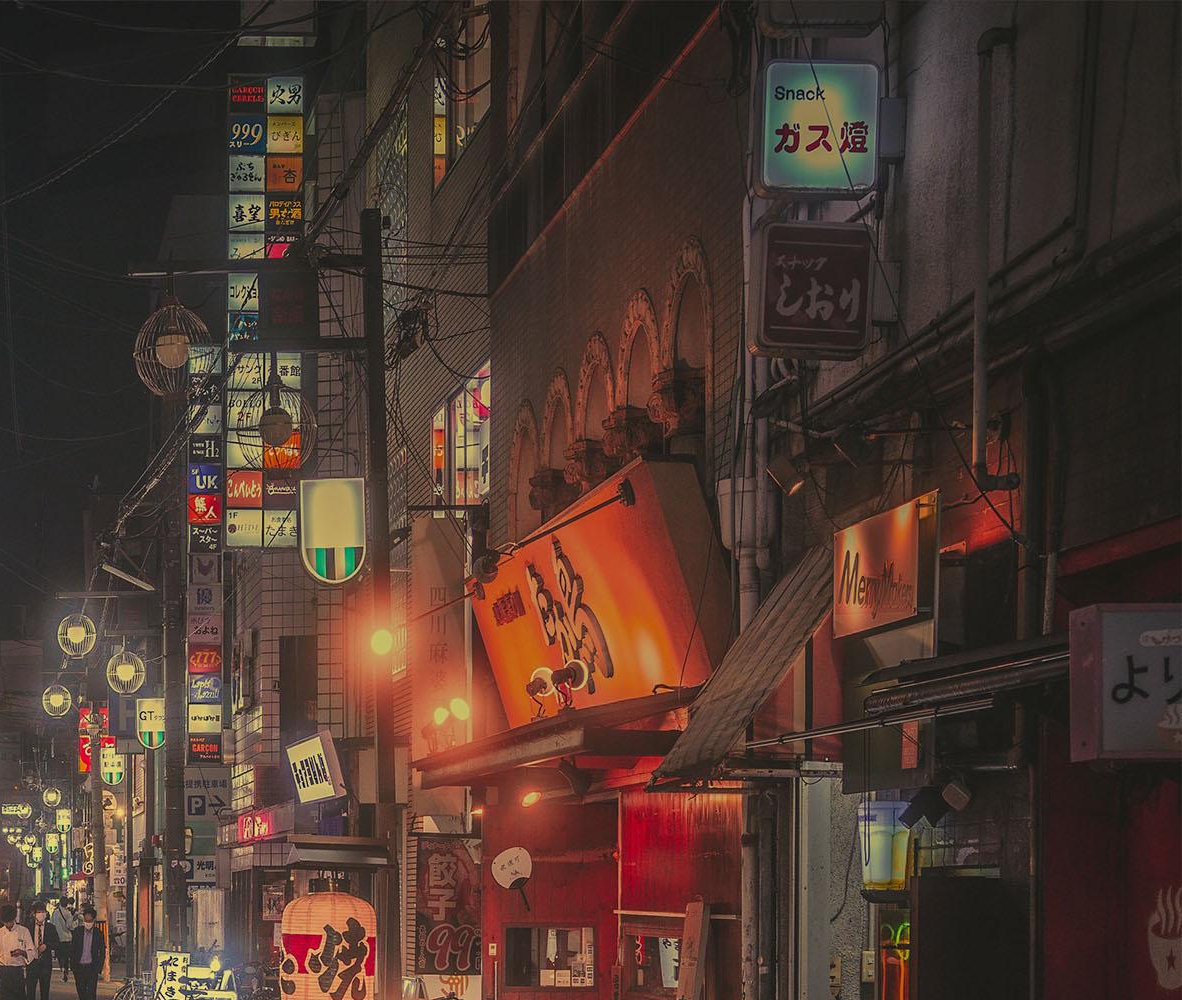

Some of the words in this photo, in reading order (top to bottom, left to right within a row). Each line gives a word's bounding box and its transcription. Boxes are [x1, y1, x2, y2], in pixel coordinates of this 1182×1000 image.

[775, 86, 826, 101] Snack
[231, 123, 263, 146] 999
[774, 121, 868, 154] ガス燈
[230, 286, 258, 299] コレクショ
[227, 480, 261, 498] こんぺいとう
[265, 526, 298, 536] たまき
[426, 853, 459, 921] 餃子
